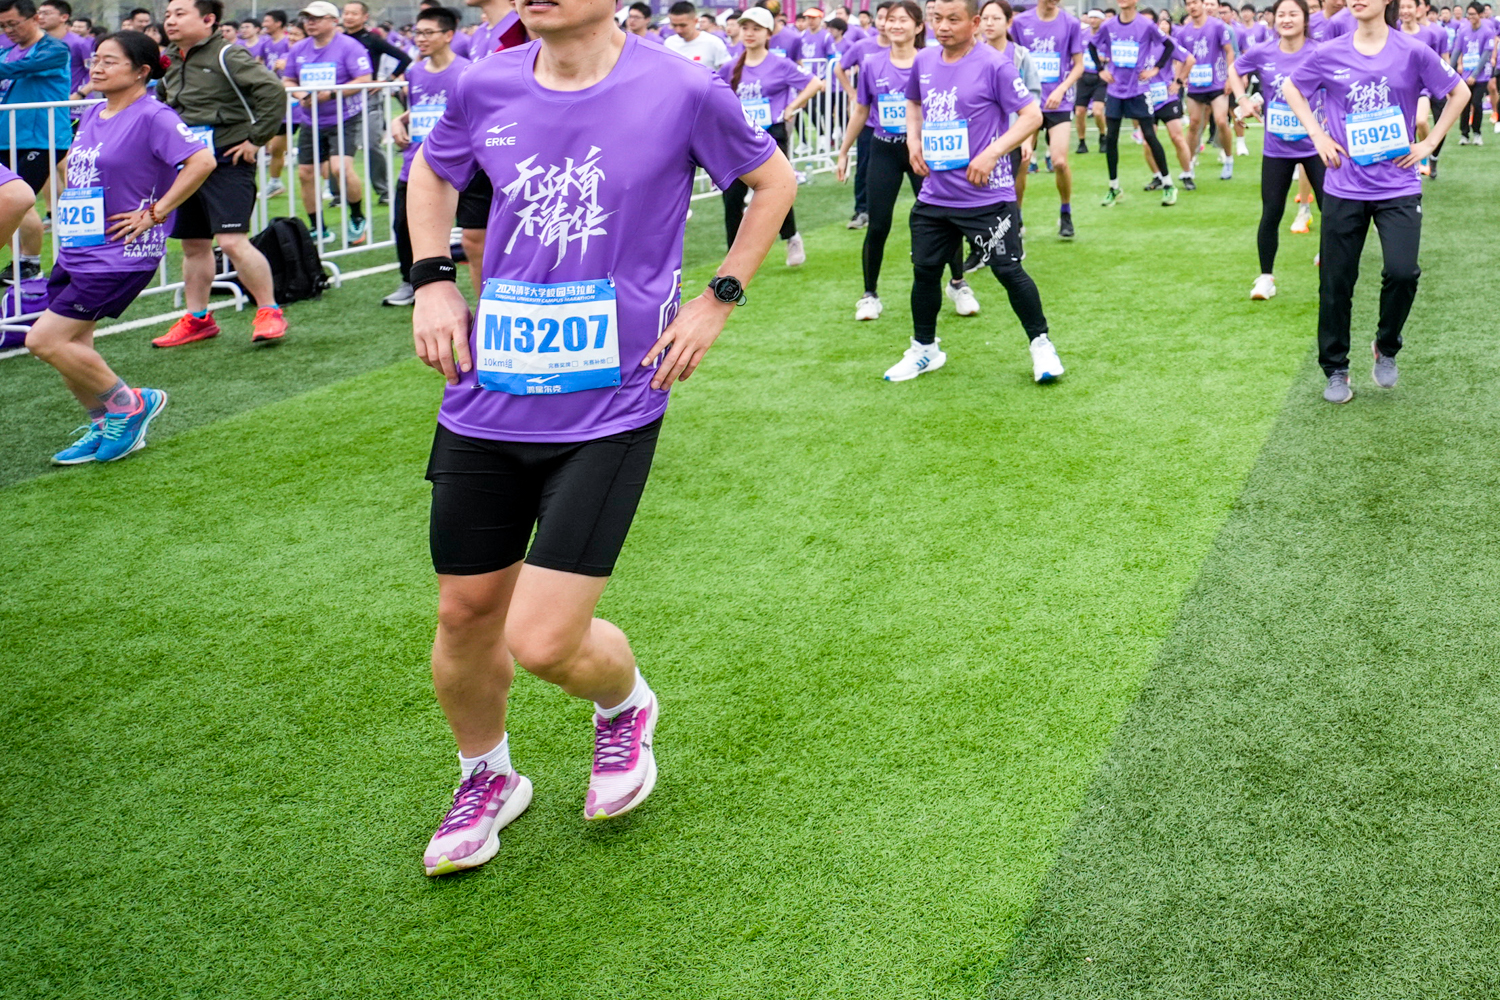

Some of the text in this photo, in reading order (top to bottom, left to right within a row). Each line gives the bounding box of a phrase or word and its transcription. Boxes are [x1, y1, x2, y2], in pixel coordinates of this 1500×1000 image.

[883, 106, 906, 119] F53
[1270, 113, 1304, 128] F589
[485, 136, 516, 147] ERKE
[1351, 123, 1401, 146] F5929
[923, 135, 963, 152] M5137
[500, 145, 606, 214] 无体育
[504, 196, 619, 273] 不清华
[484, 314, 608, 353] M3207
[484, 358, 513, 369] 10km组
